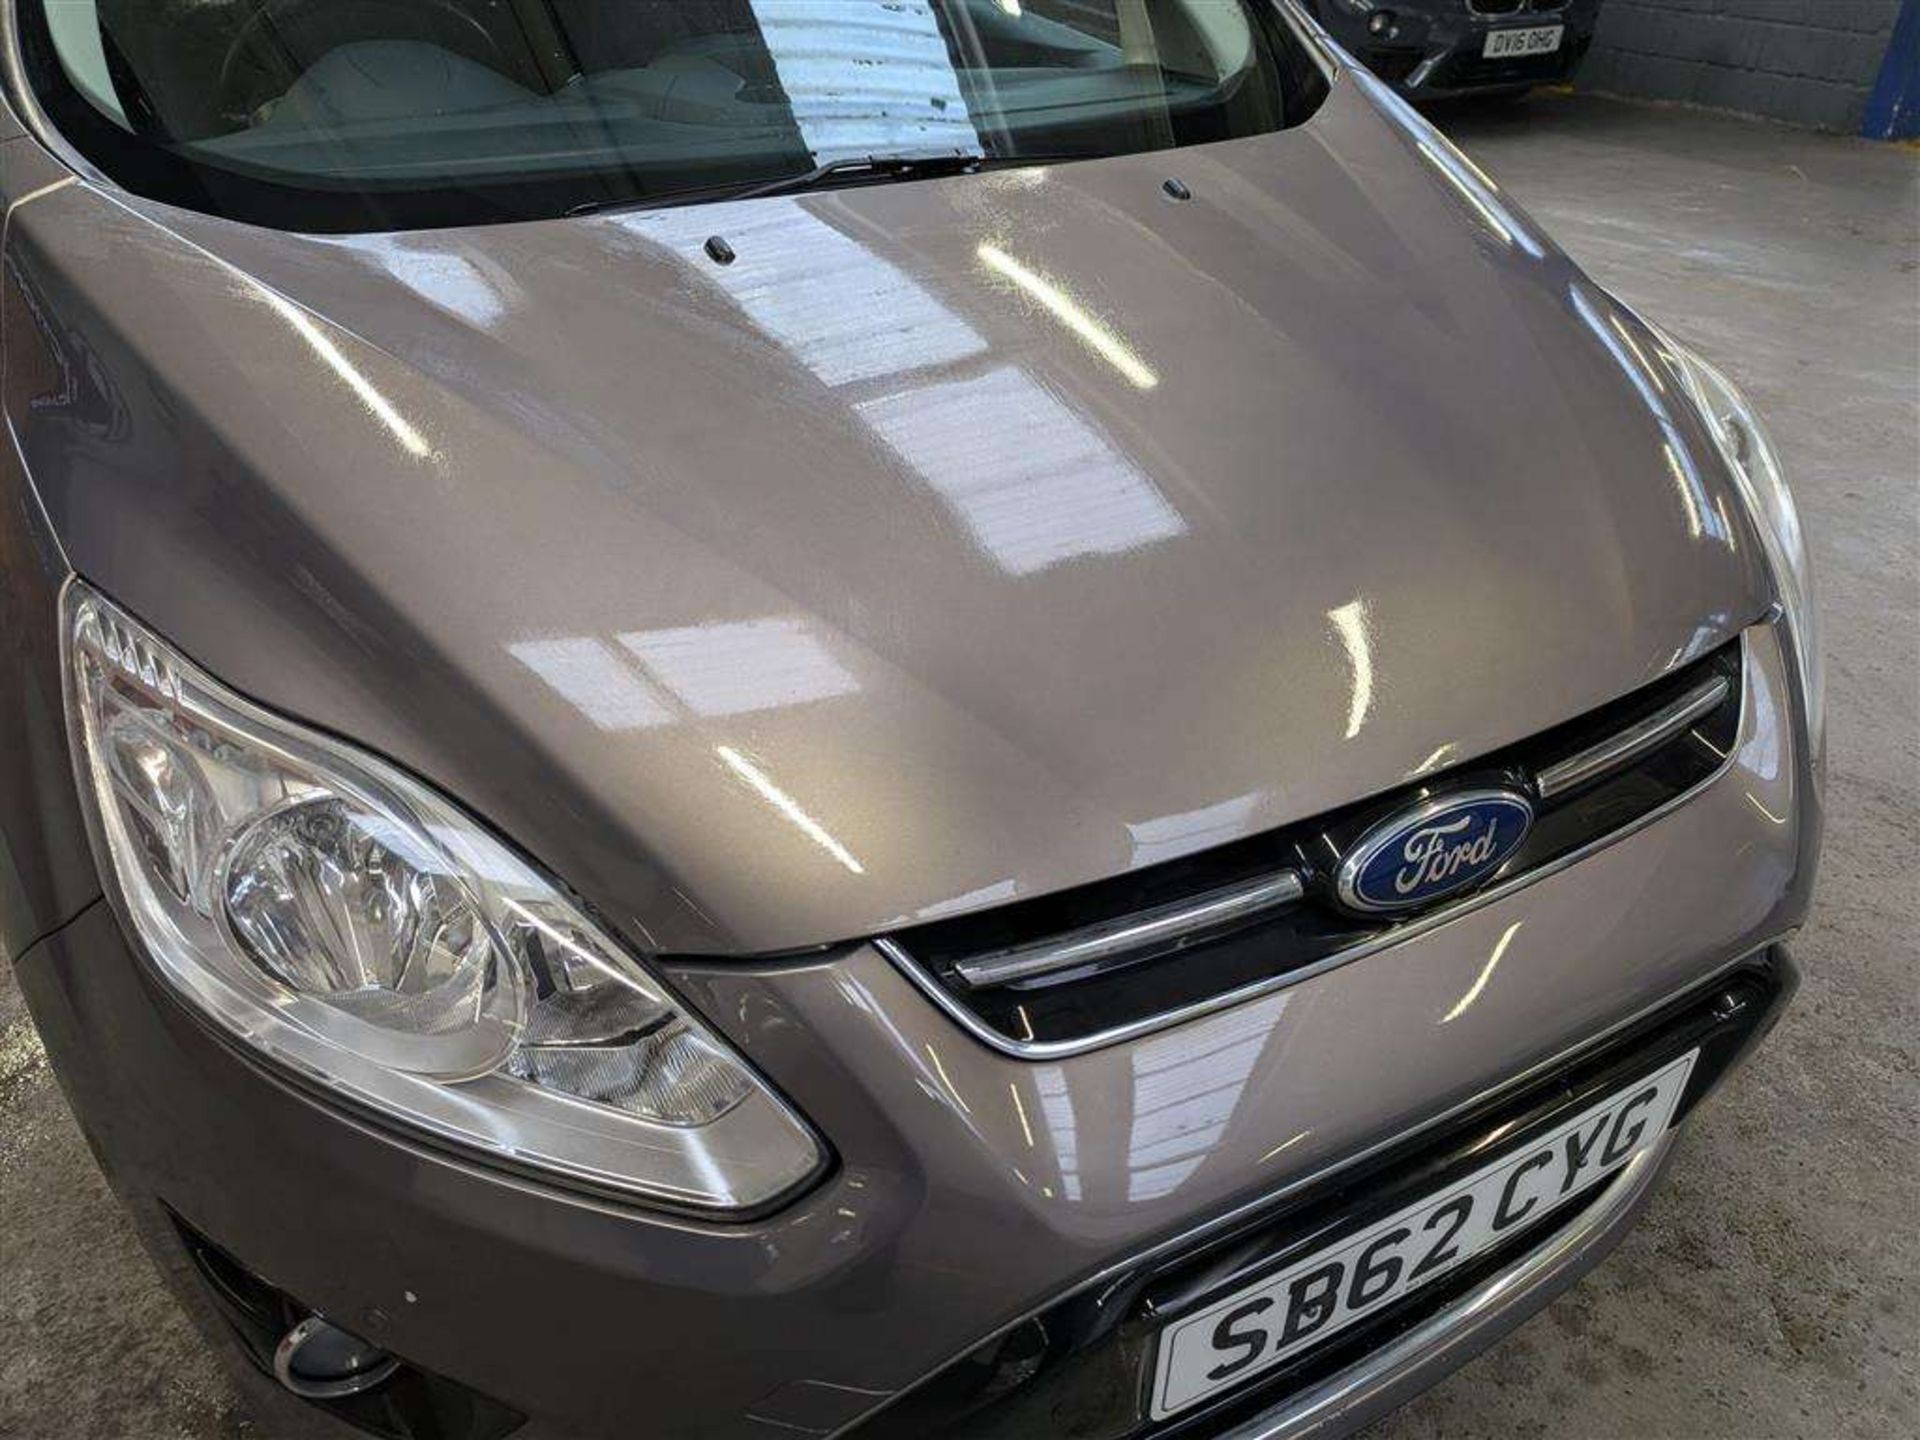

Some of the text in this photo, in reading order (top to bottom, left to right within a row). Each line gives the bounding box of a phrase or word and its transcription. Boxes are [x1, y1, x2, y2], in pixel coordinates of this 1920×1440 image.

[1394, 815, 1498, 894] Ford
[1206, 1086, 1659, 1382] SB62 CYG
